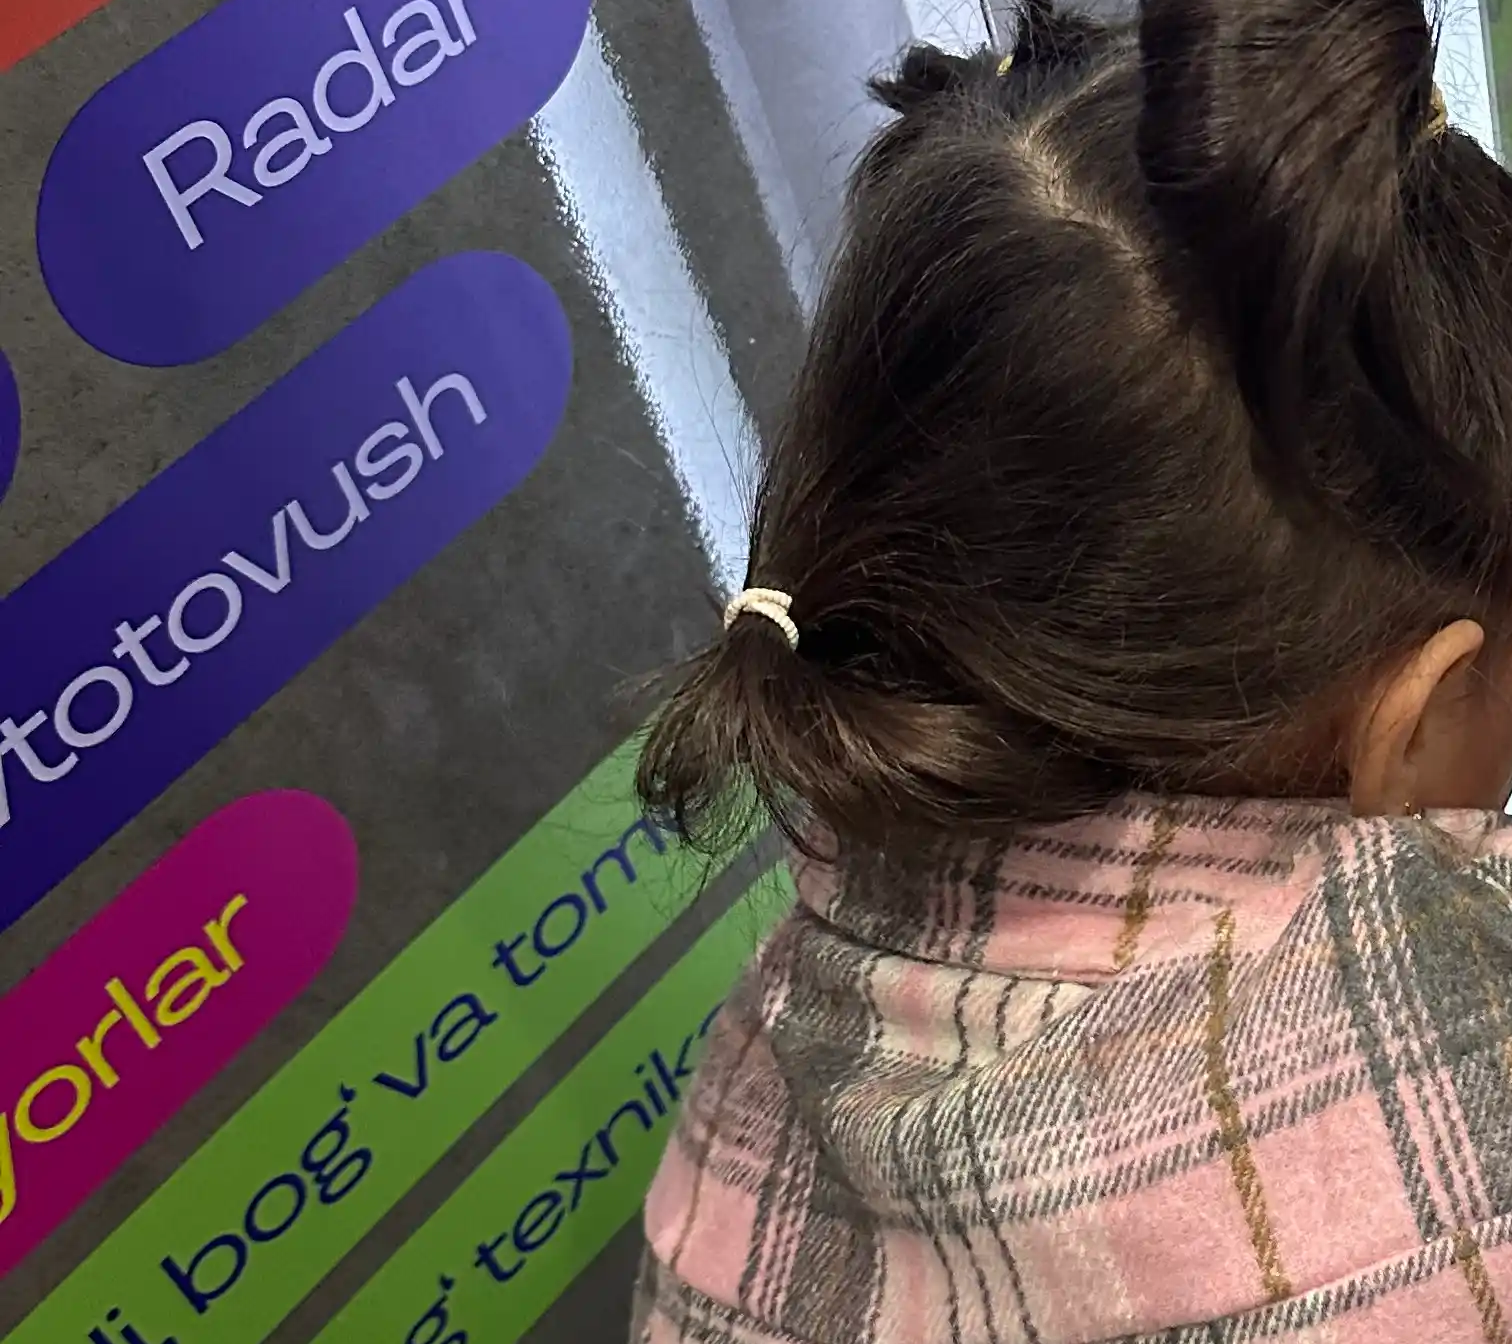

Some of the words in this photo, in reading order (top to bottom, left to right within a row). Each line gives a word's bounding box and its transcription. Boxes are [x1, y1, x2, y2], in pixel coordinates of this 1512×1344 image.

[372, 992, 498, 1099] va
[491, 806, 683, 987] tom
[474, 998, 727, 1284] texnik
